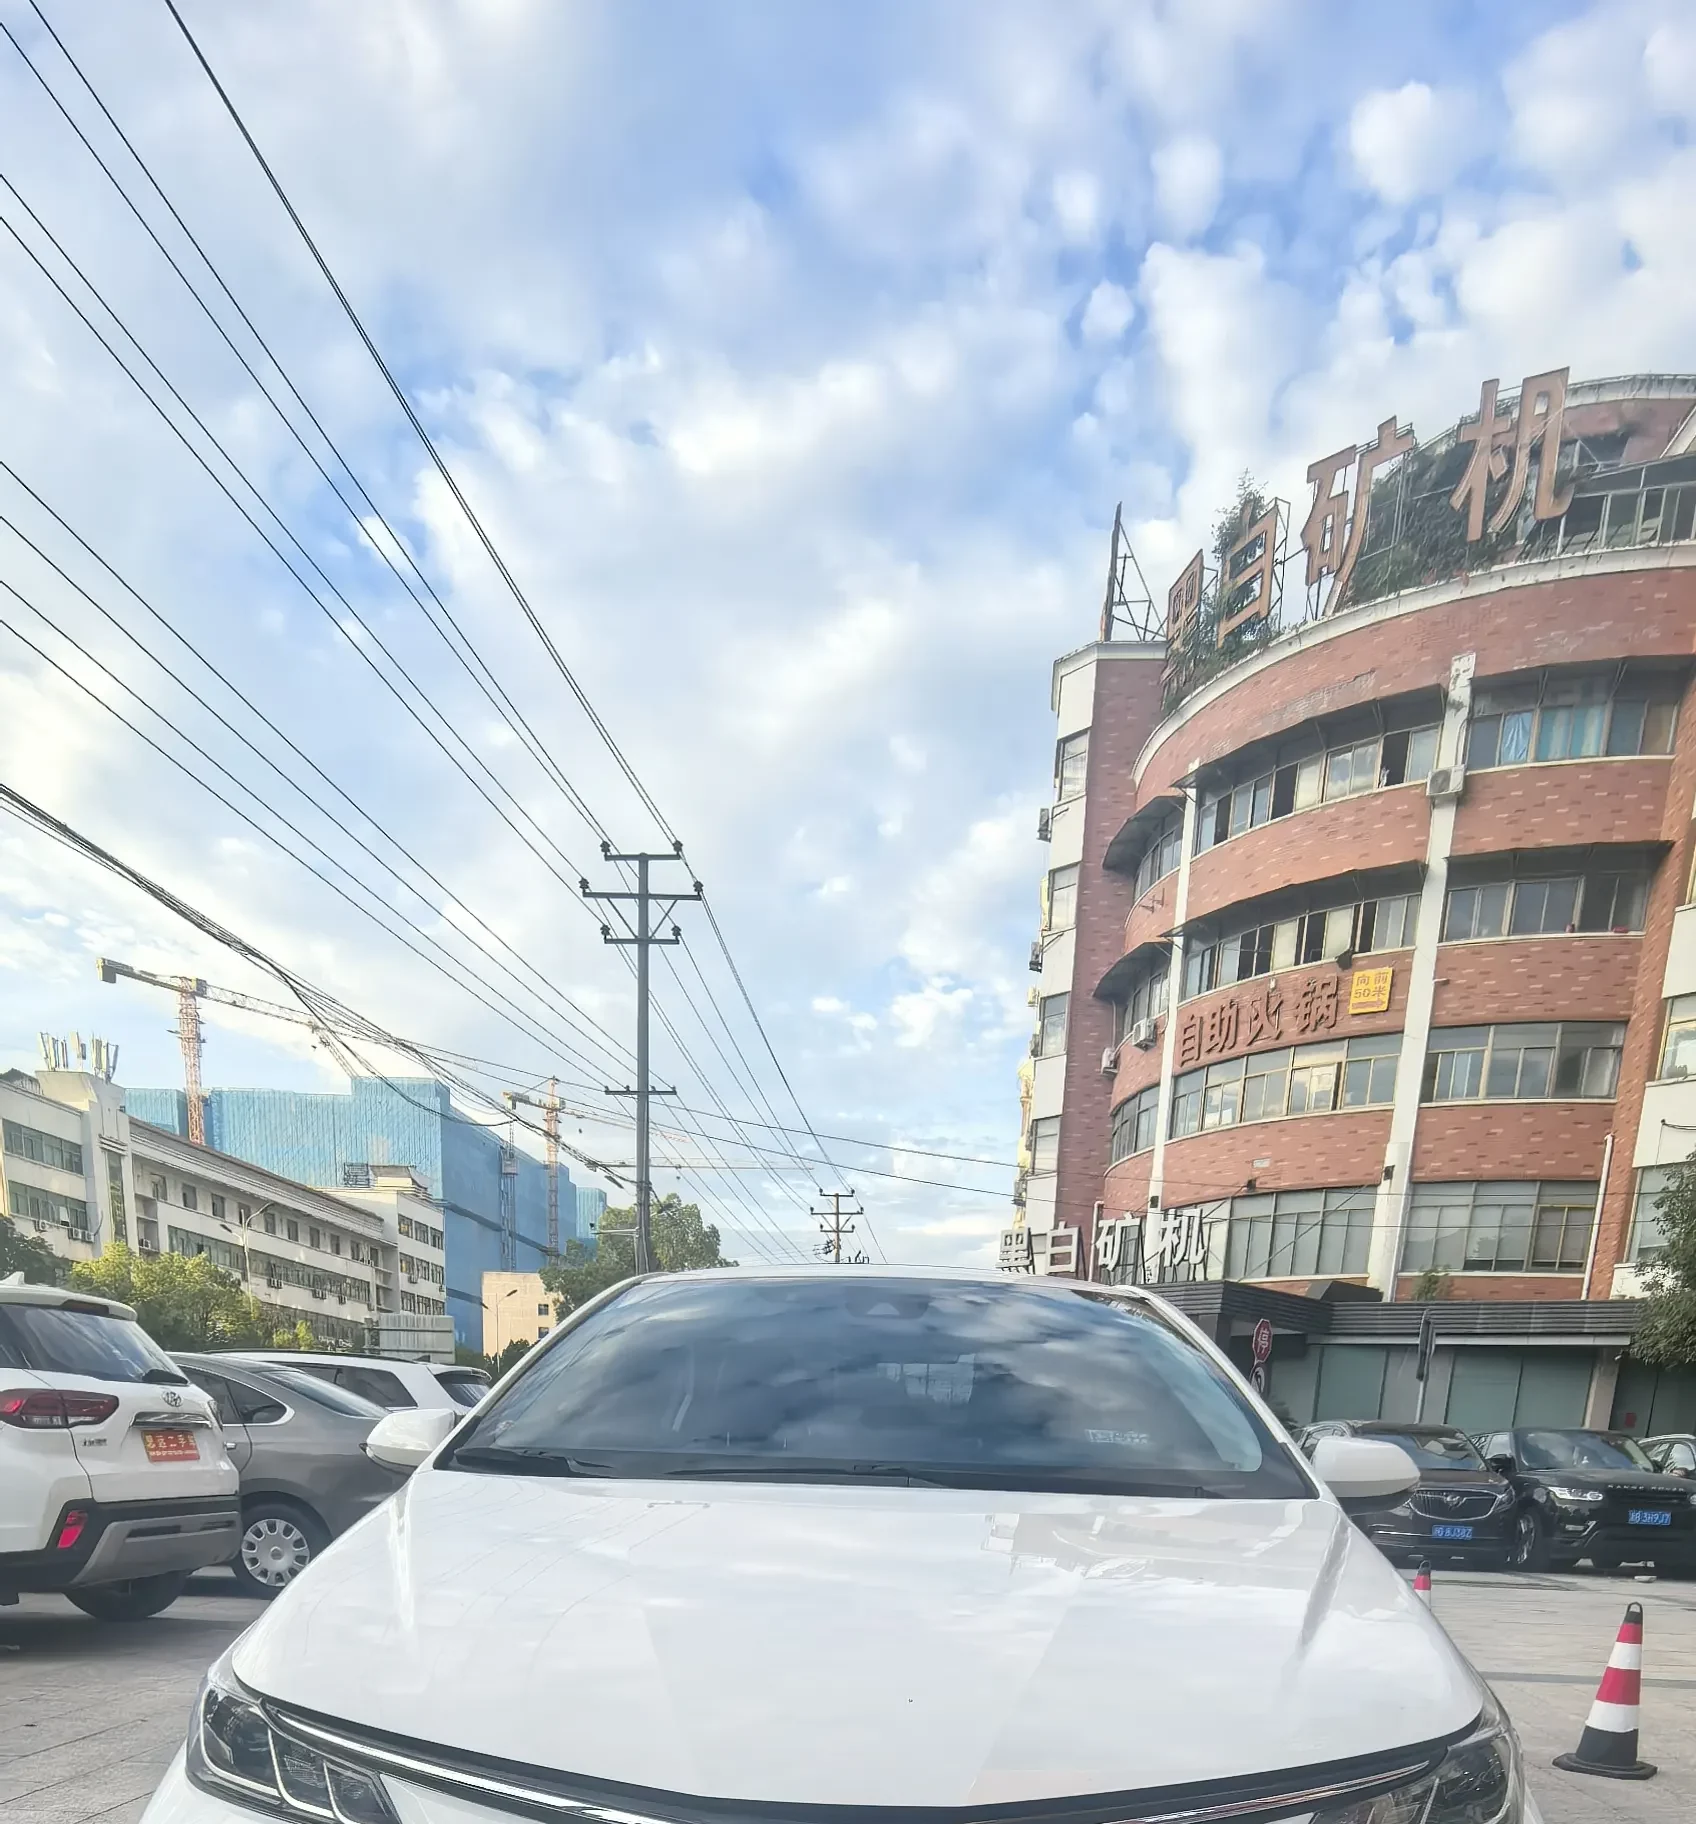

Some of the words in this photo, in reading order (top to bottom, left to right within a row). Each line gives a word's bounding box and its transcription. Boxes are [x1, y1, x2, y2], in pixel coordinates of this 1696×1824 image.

[1180, 974, 1339, 1067] 自助火锅
[996, 1208, 1206, 1274] 黑白矿机
[1257, 1327, 1270, 1354] 停
